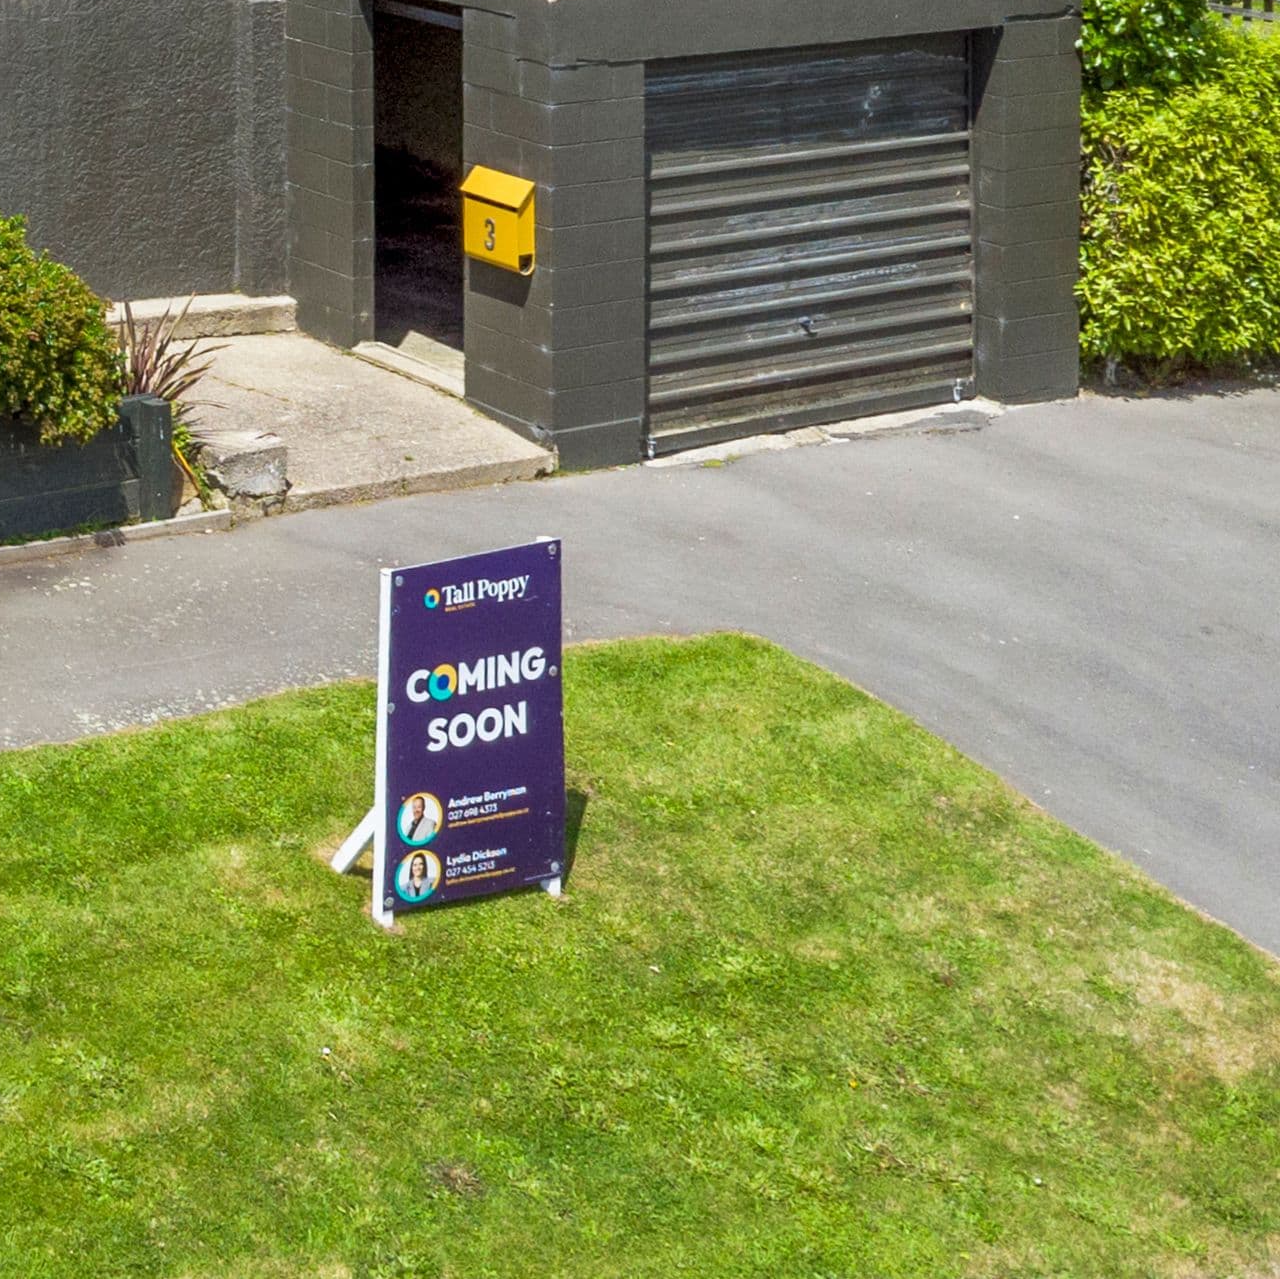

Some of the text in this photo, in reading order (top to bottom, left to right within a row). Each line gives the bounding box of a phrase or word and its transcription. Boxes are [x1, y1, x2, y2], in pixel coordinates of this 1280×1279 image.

[484, 218, 496, 251] 3
[442, 575, 530, 605] Tall Poppy
[406, 647, 546, 702] COMING
[427, 700, 527, 751] SOON
